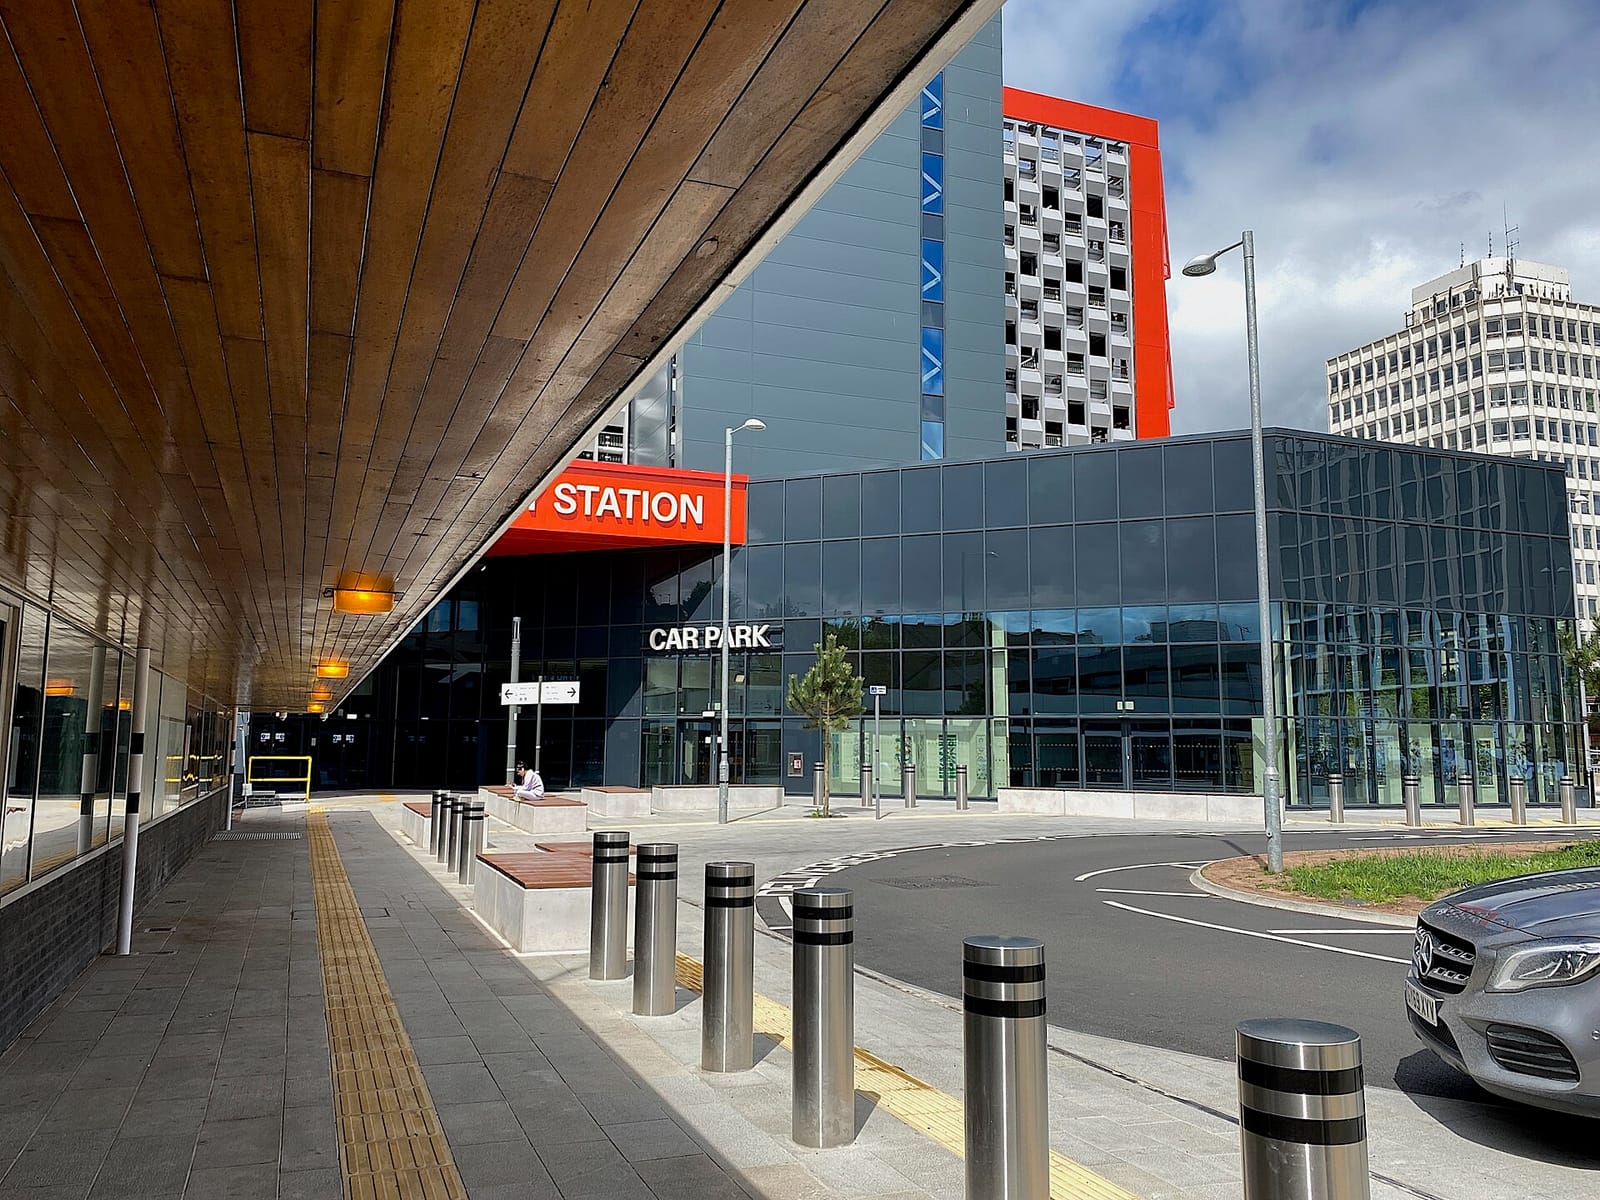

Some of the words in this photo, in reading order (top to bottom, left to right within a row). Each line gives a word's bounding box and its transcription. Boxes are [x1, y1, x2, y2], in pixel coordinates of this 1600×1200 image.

[553, 483, 703, 524] STATION
[649, 626, 699, 650] CAR
[704, 624, 771, 649] PARK
